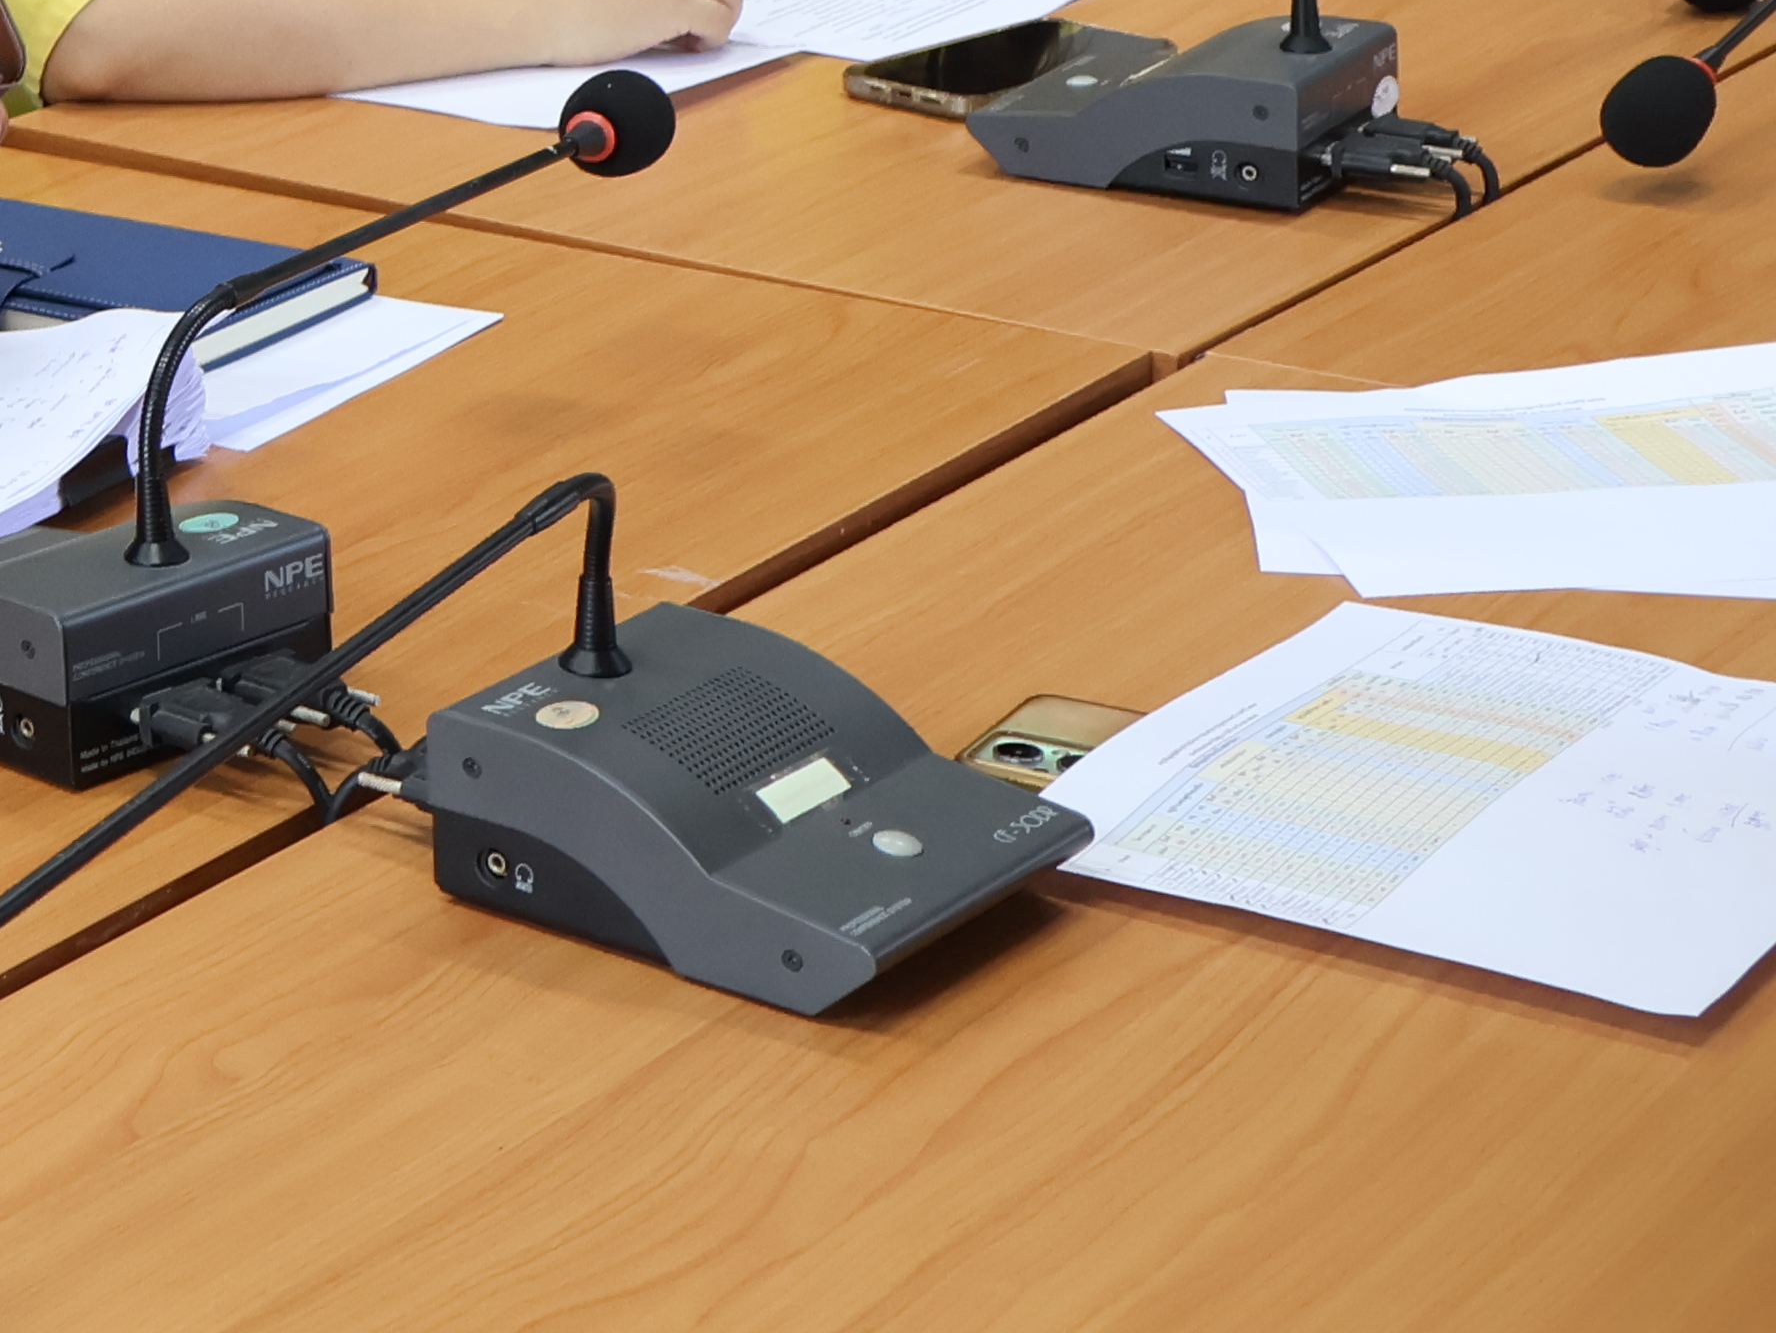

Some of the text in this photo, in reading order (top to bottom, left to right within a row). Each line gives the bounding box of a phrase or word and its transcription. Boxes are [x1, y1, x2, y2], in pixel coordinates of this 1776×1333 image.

[208, 517, 279, 545] NPE
[263, 552, 326, 593] NPE
[480, 681, 552, 716] NPE
